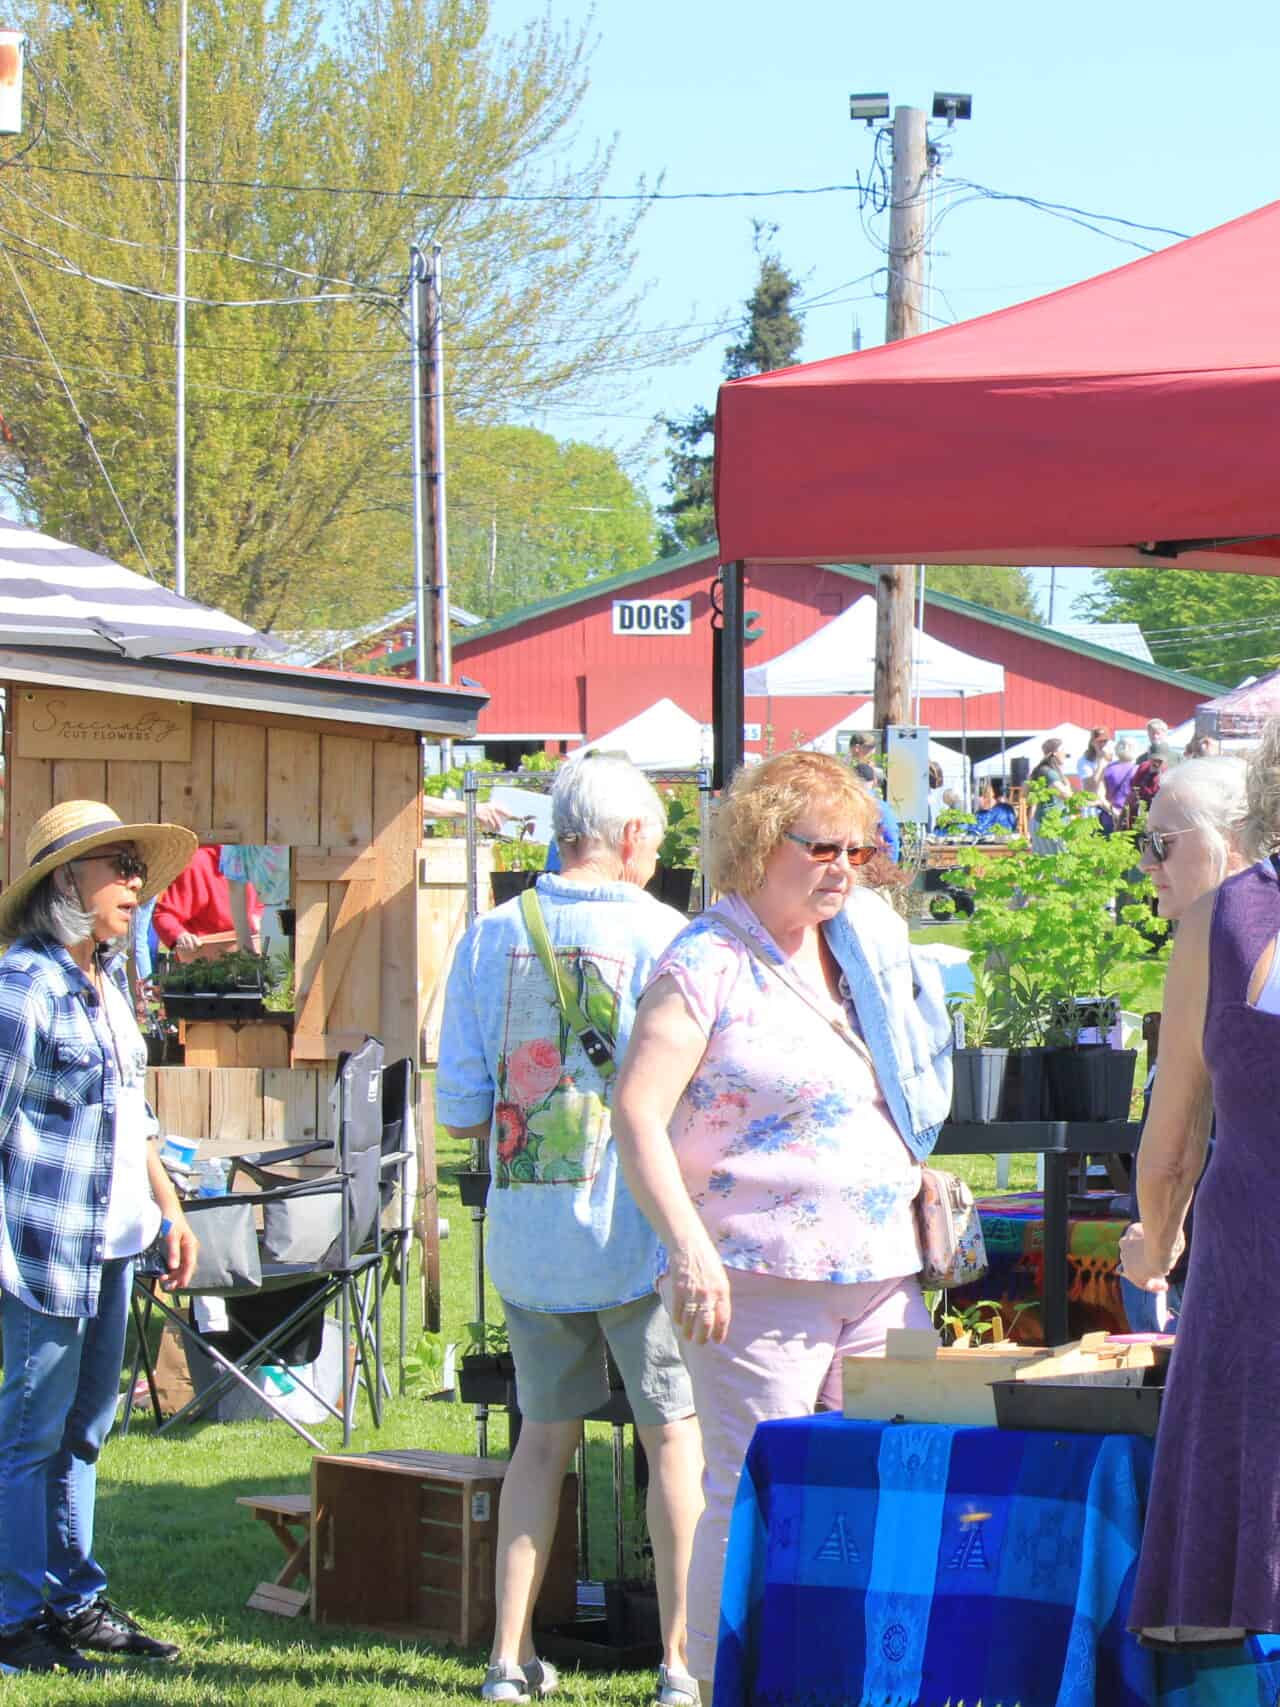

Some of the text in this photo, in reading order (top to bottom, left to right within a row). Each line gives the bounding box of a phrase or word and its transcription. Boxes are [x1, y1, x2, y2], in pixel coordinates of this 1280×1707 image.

[619, 604, 685, 631] DOGS
[32, 699, 181, 743] Specialty
[63, 730, 151, 741] CUT FLOWERS
